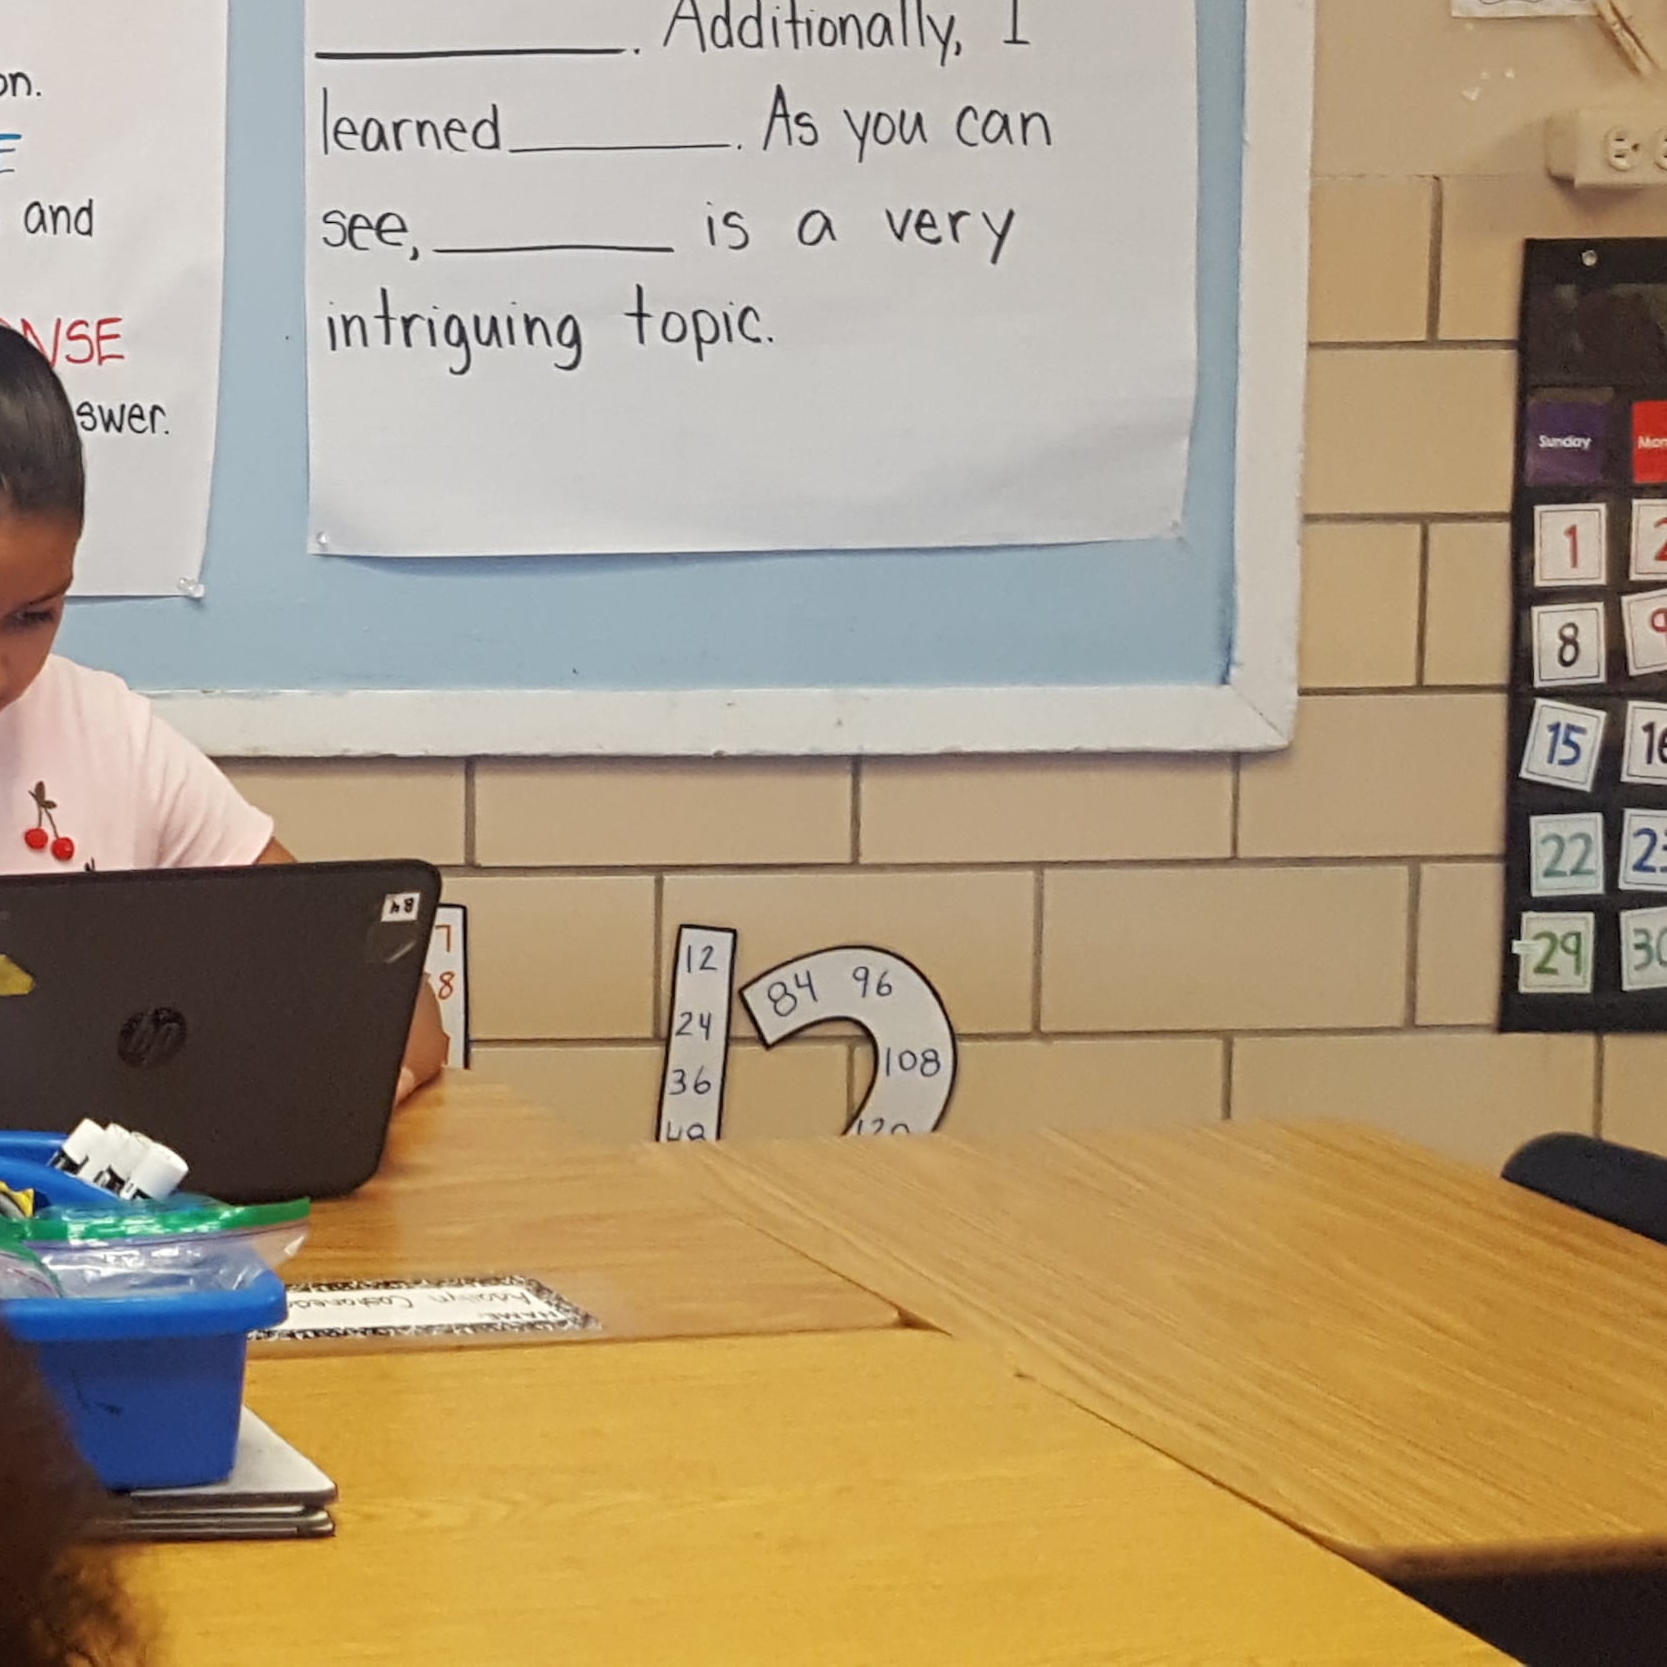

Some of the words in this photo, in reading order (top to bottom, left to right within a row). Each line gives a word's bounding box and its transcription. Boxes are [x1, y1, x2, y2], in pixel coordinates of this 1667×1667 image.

[321, 209, 420, 262] see,
[706, 200, 750, 251] is
[796, 209, 838, 247] a
[884, 207, 1016, 266] very
[326, 286, 583, 377] intriguing
[622, 282, 774, 362] topic.
[1539, 434, 1592, 450] Sunday
[1564, 524, 1578, 568] 1
[1558, 622, 1580, 667] 8
[1546, 721, 1587, 766] 15
[1541, 833, 1596, 877] 22
[686, 944, 718, 975] 12
[1533, 931, 1583, 976] 29
[766, 969, 819, 1018] 84
[851, 965, 893, 999] 96
[674, 1010, 713, 1042] 24
[669, 1064, 712, 1096] 36
[885, 1046, 942, 1078] 108
